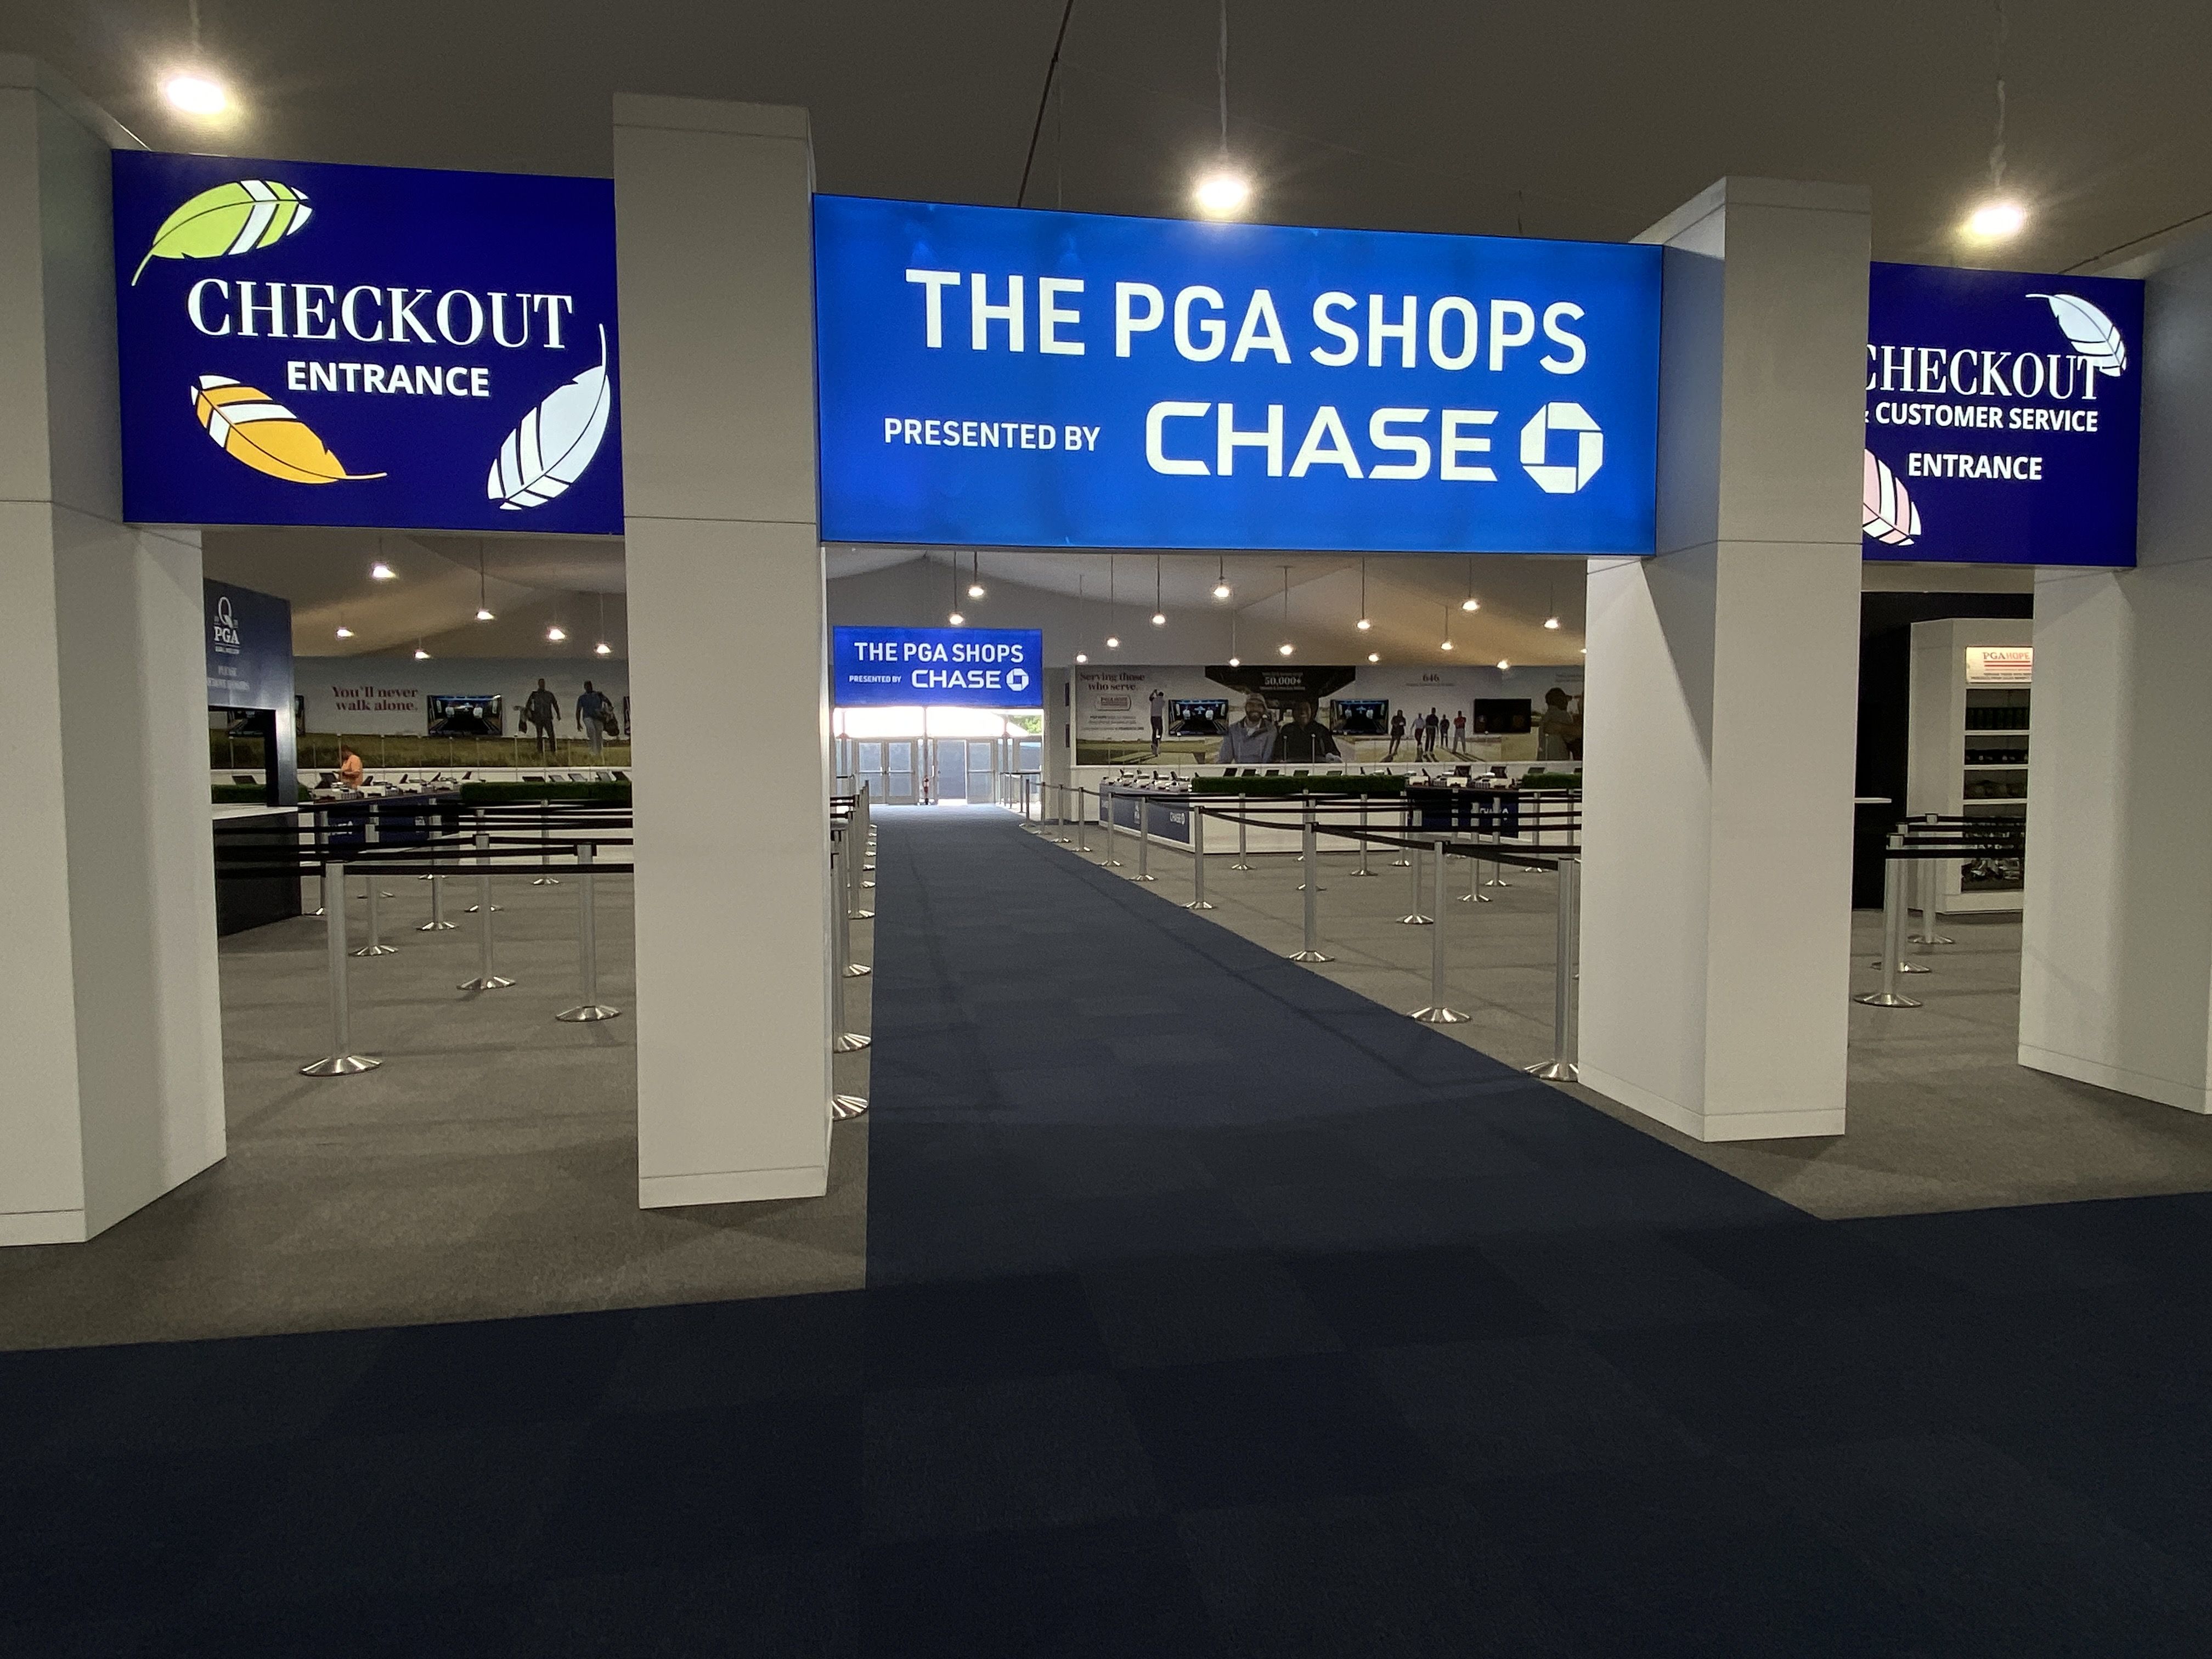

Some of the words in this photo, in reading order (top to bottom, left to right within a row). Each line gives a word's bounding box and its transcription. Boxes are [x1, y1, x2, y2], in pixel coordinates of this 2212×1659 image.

[188, 278, 572, 348] CHECKOUT
[906, 269, 1085, 356] THE
[1115, 281, 1291, 364] PGA
[1310, 291, 1587, 374] SHOPS
[287, 360, 489, 397] ENTRANCE
[1876, 402, 2004, 428] CUSTOMER
[2009, 408, 2098, 432] SERVICE
[884, 417, 1056, 449] PRESENTED
[1065, 426, 1101, 451] BY
[1146, 401, 1499, 482] CHASE
[1908, 453, 2042, 480] ENTRANCE
[213, 626, 240, 645] PGA
[854, 642, 898, 661] THE
[904, 643, 949, 662] PGA
[952, 644, 1024, 663] SHOPS
[849, 675, 890, 683] PRESENTED
[891, 675, 901, 683] BY
[911, 669, 1002, 689] CHASE
[1079, 673, 1117, 682] Serving
[1119, 673, 1145, 681] those
[1088, 682, 1109, 691] who
[1422, 673, 1440, 682] 646
[332, 686, 374, 698] You'll
[377, 689, 419, 698] never
[335, 699, 371, 711] walk
[374, 699, 419, 712] alone.
